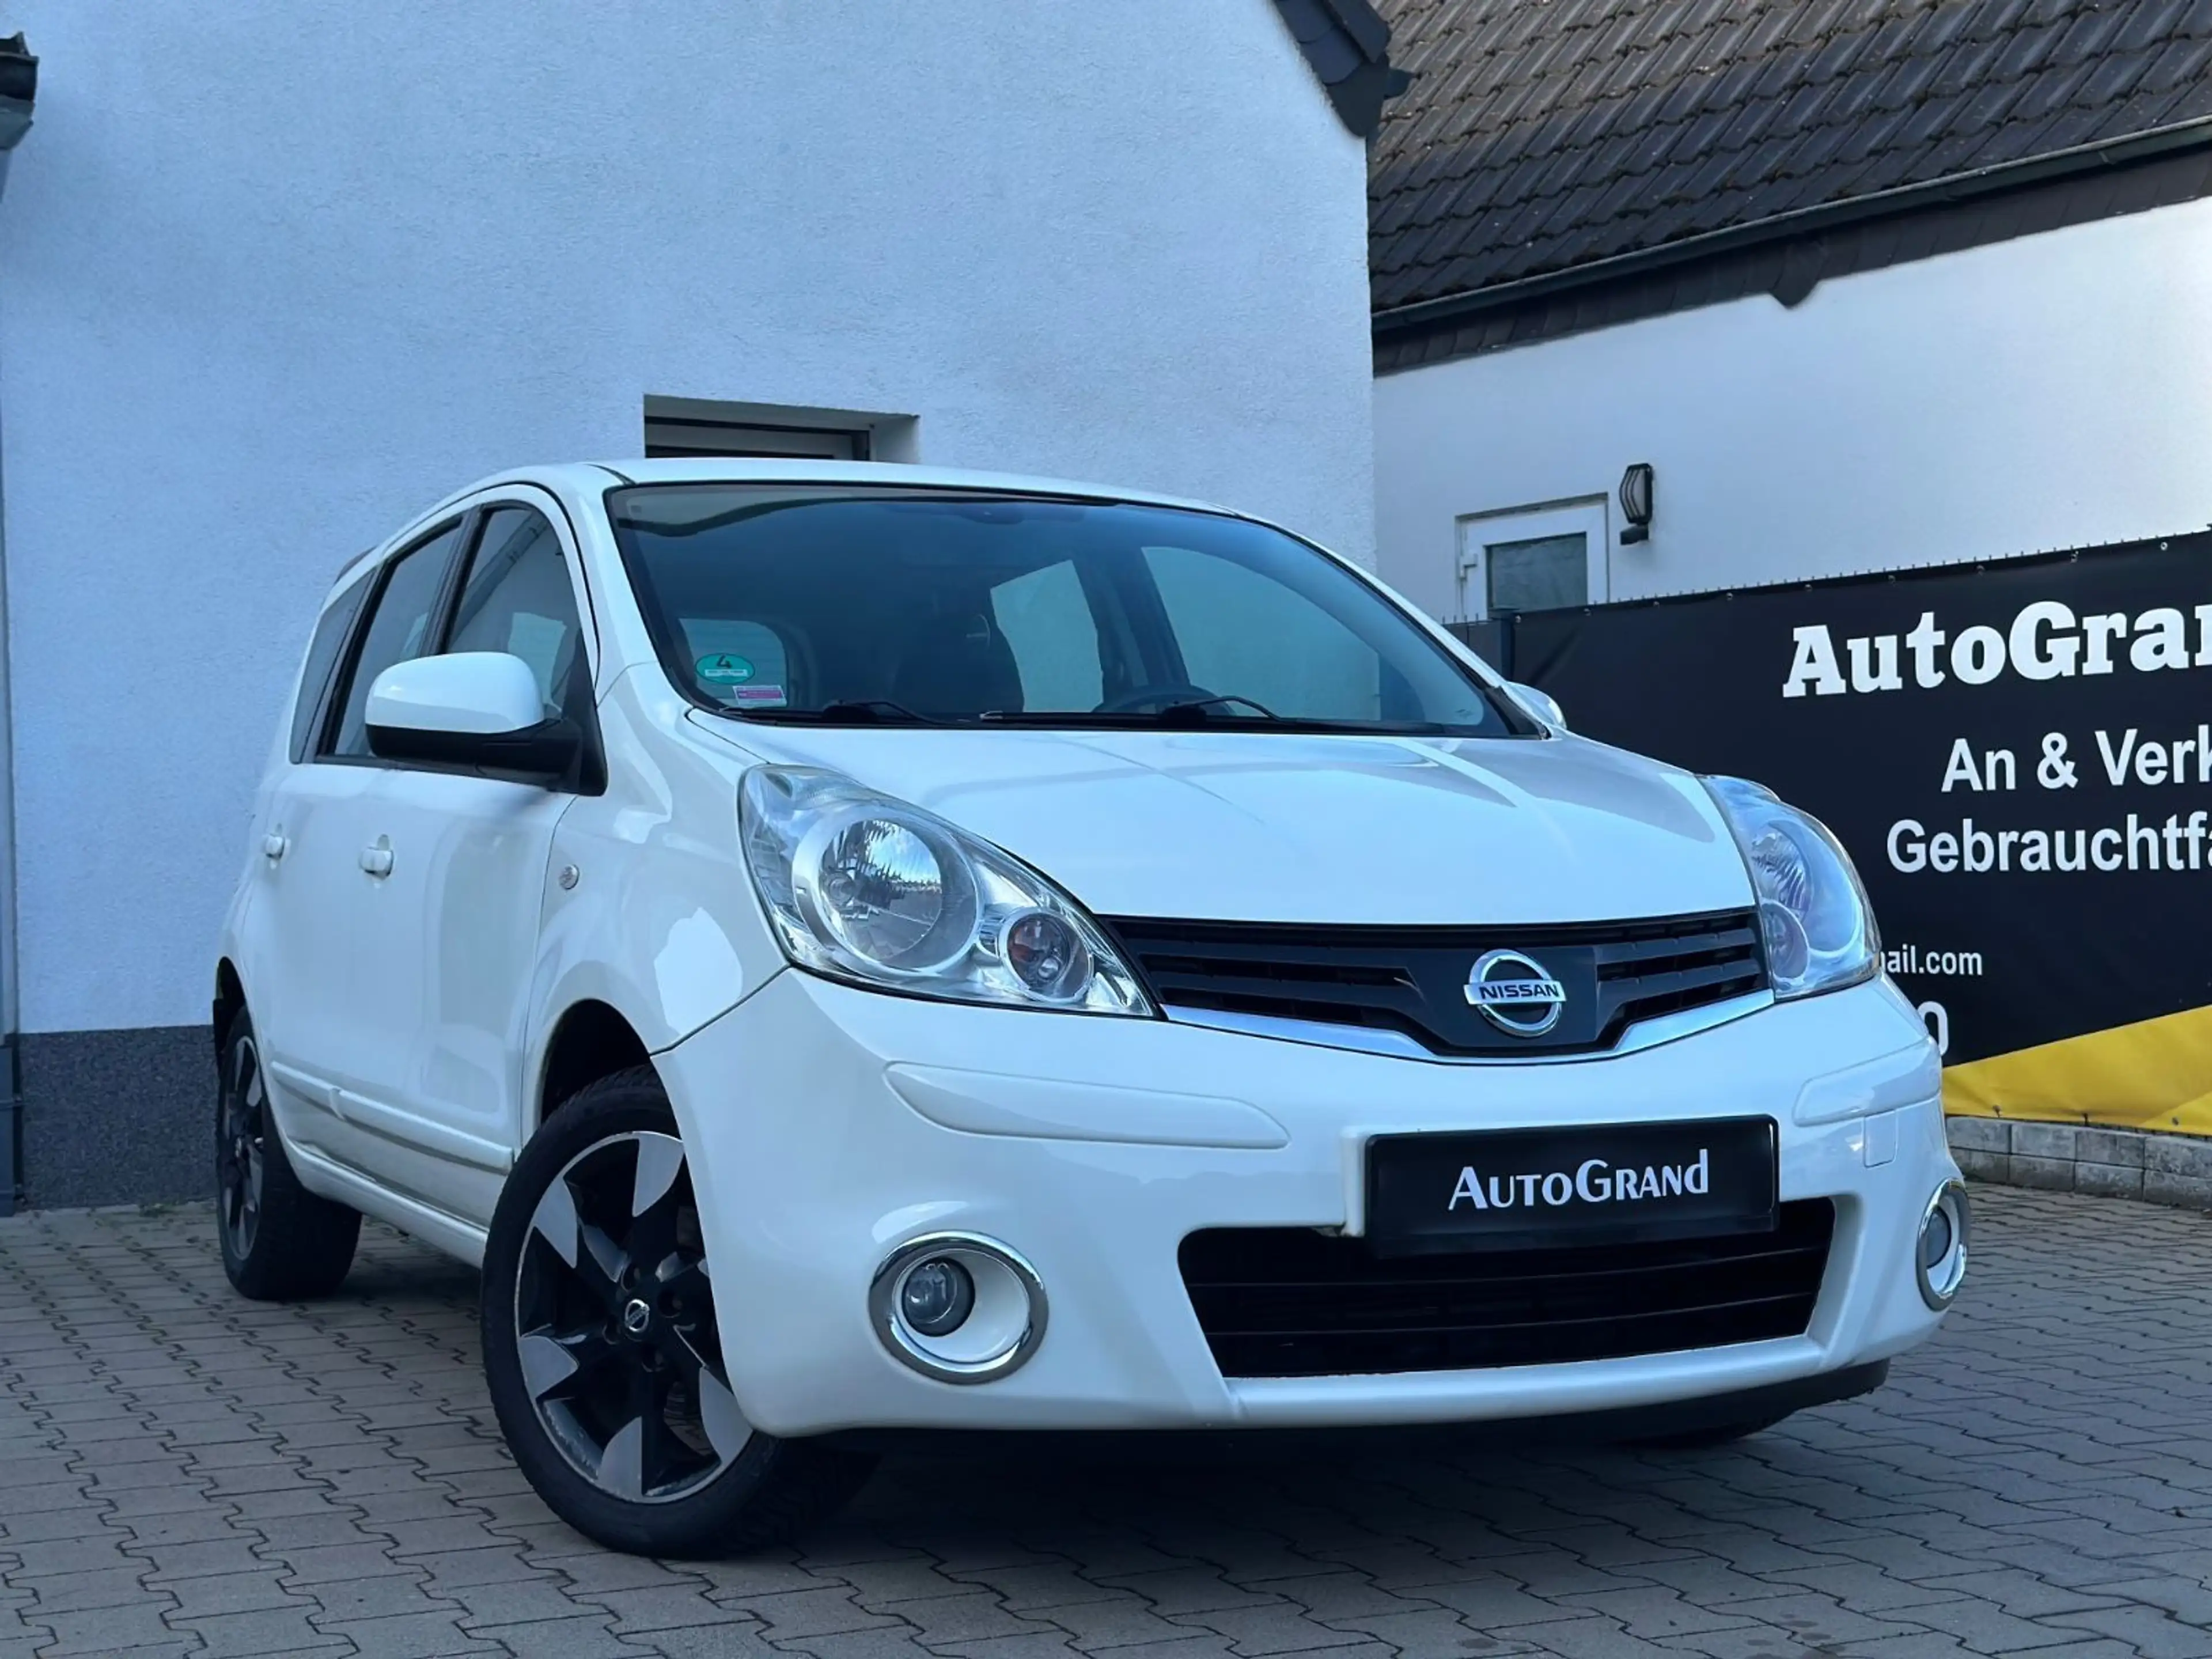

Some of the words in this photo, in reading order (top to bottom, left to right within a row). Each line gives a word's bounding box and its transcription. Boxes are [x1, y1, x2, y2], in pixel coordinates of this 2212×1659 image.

[1941, 738, 2016, 792] An
[2037, 732, 2078, 789] &
[1887, 810, 2212, 873] Gebrauchtf
[1880, 944, 1983, 975] ail.com
[1479, 984, 1560, 999] NISSAN
